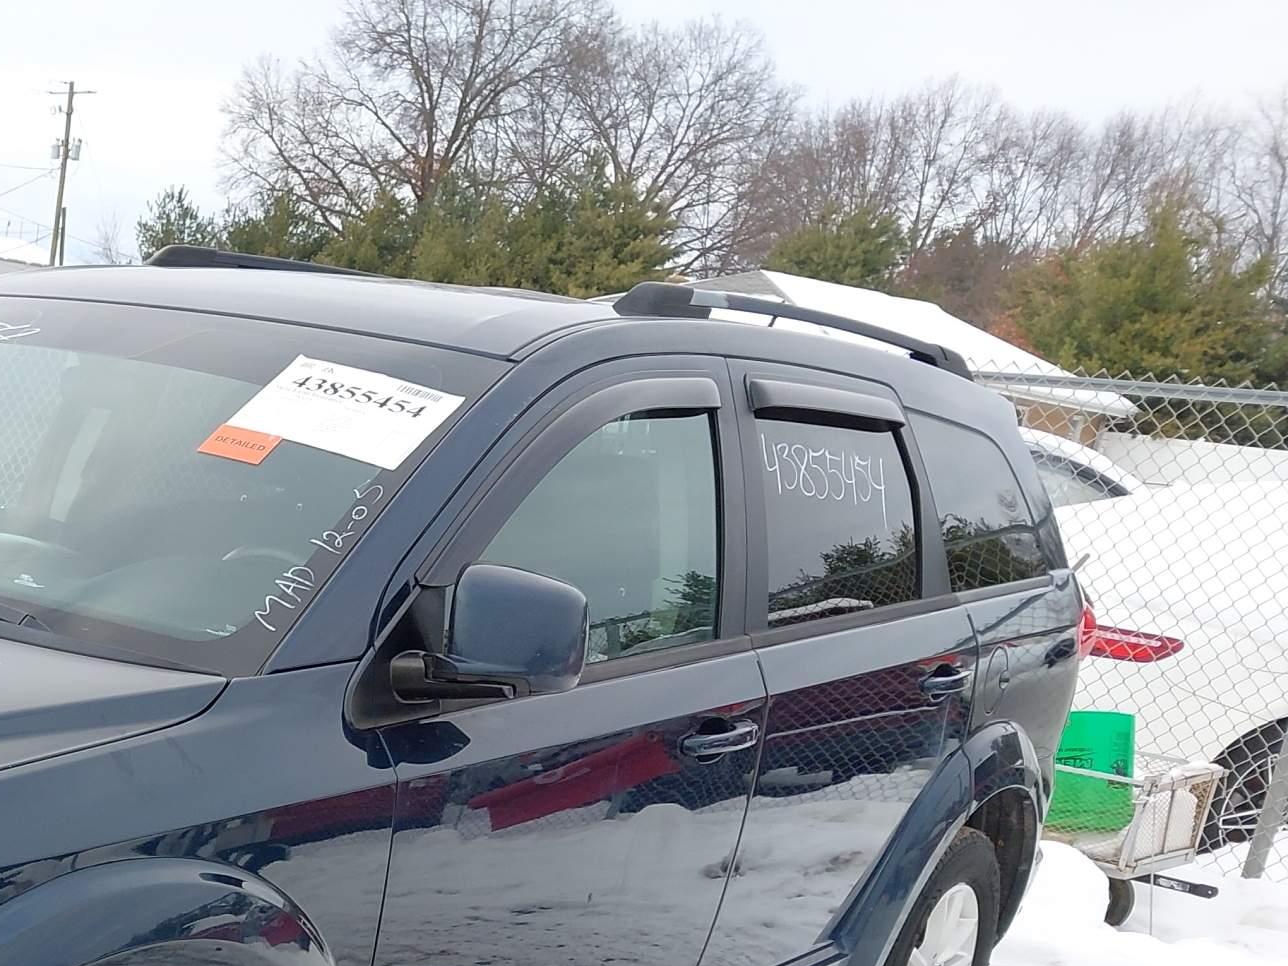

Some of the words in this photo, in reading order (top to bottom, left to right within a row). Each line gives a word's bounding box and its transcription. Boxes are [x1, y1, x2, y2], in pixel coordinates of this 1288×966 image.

[292, 375, 428, 418] 43855454
[215, 434, 266, 452] DETAILED
[761, 433, 887, 528] 43855454
[255, 566, 315, 631] MAD
[310, 480, 384, 555] 12-05
